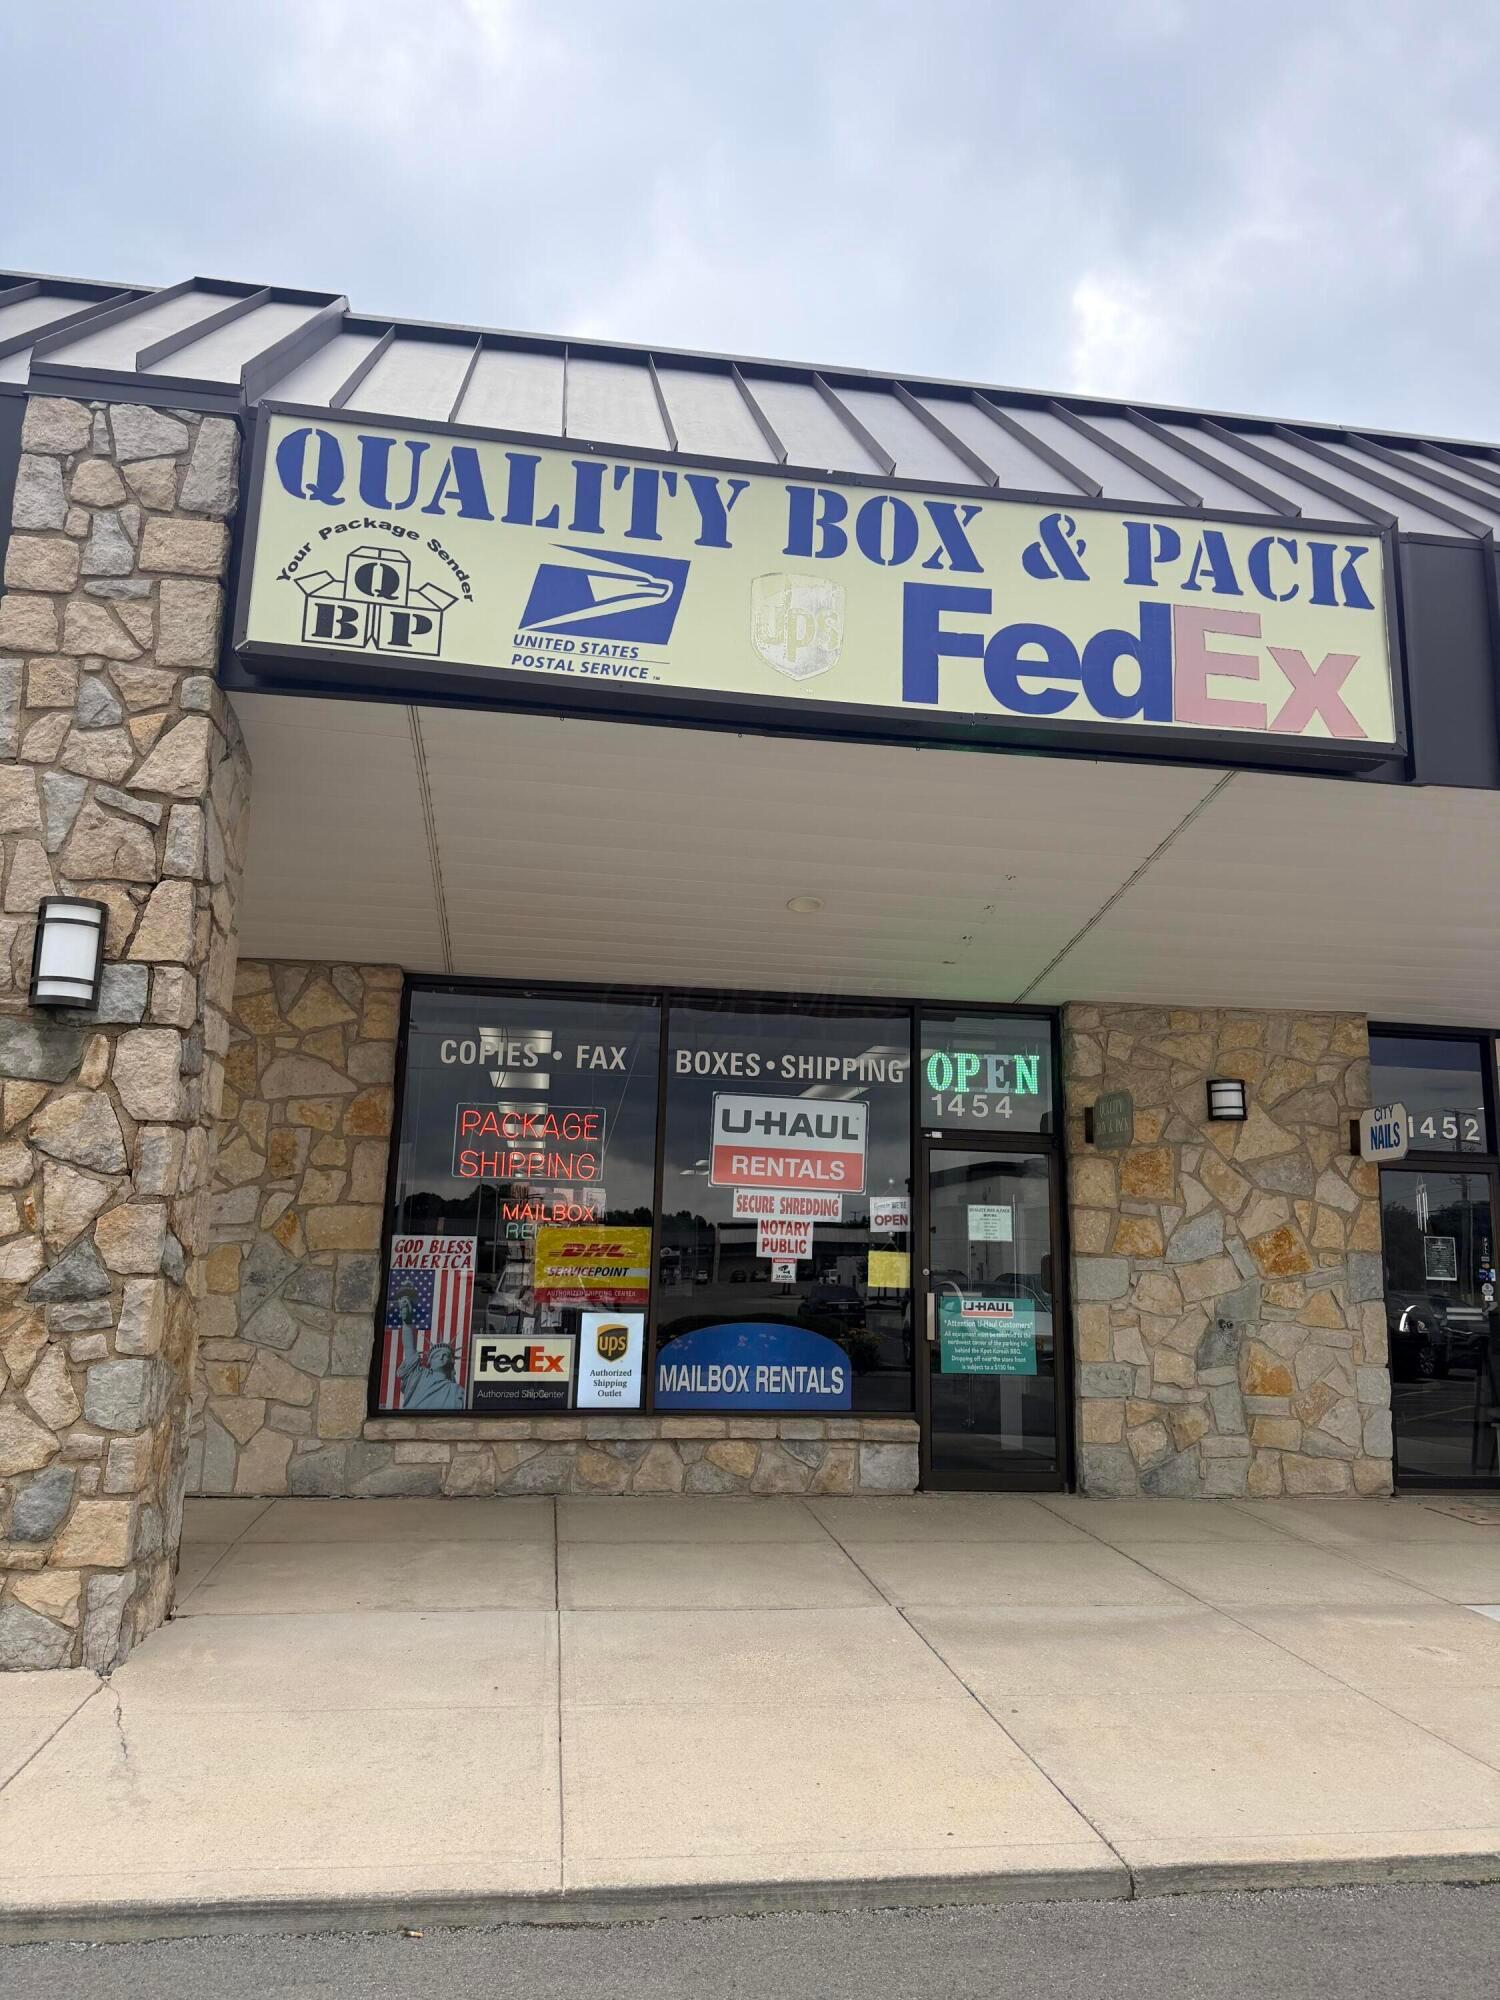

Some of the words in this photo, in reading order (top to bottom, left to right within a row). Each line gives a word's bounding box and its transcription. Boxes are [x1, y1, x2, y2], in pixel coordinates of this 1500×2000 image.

[275, 427, 751, 549] QUALITY
[781, 484, 985, 573] BOX
[1021, 512, 1090, 581] &
[1122, 520, 1377, 610] PACK
[276, 542, 312, 582] Your
[318, 517, 420, 541] Package
[427, 538, 474, 603] Sender
[354, 562, 400, 600] Q
[312, 602, 359, 640] B
[387, 611, 433, 647] P
[513, 634, 575, 652] UNITED
[580, 642, 639, 659] STATES
[511, 653, 575, 672] POSTAL
[580, 661, 649, 679] SERVICE
[902, 582, 1368, 739] FedEx
[440, 1039, 539, 1067] COPIES
[575, 1045, 628, 1070] FAX
[675, 1049, 761, 1077] BOXES
[780, 1054, 905, 1083] SHIPPING
[927, 1052, 1040, 1095] OPEN
[931, 1093, 1013, 1119] 1454
[1374, 1105, 1394, 1122] CITY
[461, 1110, 599, 1140] PACKAGE
[721, 1108, 859, 1141] U-HAUL
[1370, 1122, 1400, 1150] NAILS
[1408, 1115, 1480, 1141] 1452
[459, 1150, 596, 1180] SHIPPING
[731, 1155, 845, 1181] RENTALS
[503, 1203, 595, 1221] MAILBOX
[736, 1194, 775, 1213] SECURE
[779, 1197, 839, 1217] SHREDDING
[760, 1220, 811, 1236] NOTARY
[874, 1214, 908, 1226] OPEN
[394, 1239, 424, 1254] GOD
[429, 1239, 474, 1254] BLESS
[560, 1243, 625, 1257] DHL
[761, 1237, 807, 1254] PUBLIC
[392, 1254, 472, 1269] AMERICA
[547, 1266, 629, 1277] SERVICEPOINT
[963, 1302, 1013, 1312] U-HAUL
[480, 1346, 565, 1373] FedEx
[599, 1336, 626, 1357] ups
[589, 1369, 632, 1377] Authorized
[593, 1379, 628, 1389] Shipping
[659, 1364, 751, 1393] MAILBOX
[755, 1365, 844, 1394] RENTALS
[477, 1389, 520, 1398] Authorized
[521, 1389, 565, 1399] ShipCenter
[597, 1389, 622, 1398] Outlet
